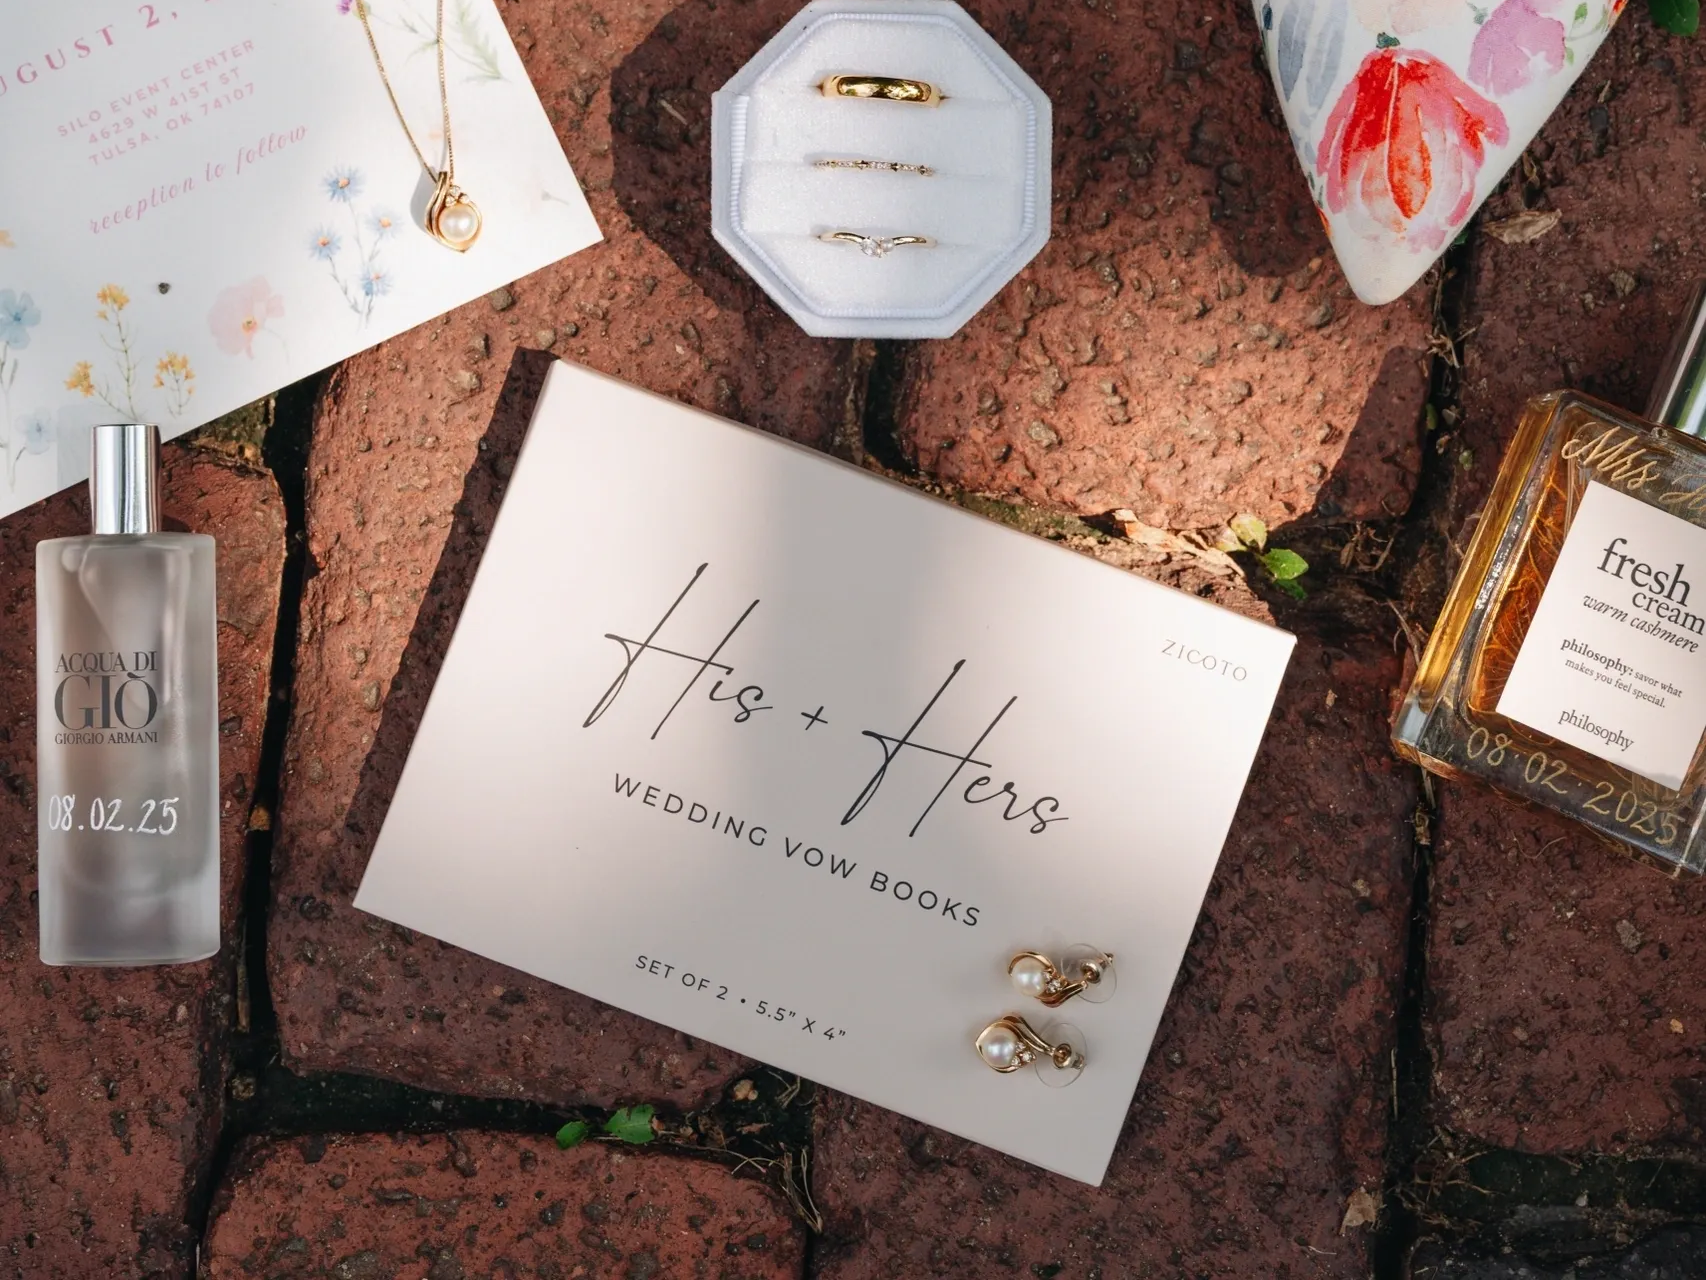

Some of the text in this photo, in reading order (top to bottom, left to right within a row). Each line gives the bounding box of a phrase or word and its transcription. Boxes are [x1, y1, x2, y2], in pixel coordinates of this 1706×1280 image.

[138, 4, 178, 29] 2,
[57, 39, 254, 137] SILO EVENT CENTER
[88, 66, 241, 144] 4629 W 41ST ST
[165, 112, 193, 131] OK
[200, 82, 255, 116] 74107
[90, 123, 308, 234] reception to follow
[1561, 422, 1661, 490] Mrs
[1597, 537, 1691, 608] fresh
[1583, 595, 1699, 654] warm cashmere
[1632, 591, 1706, 636] cream
[55, 650, 158, 673] ACQUA DI
[1161, 638, 1247, 681] ZICOTO
[1560, 638, 1683, 698] philosophy: savor what
[1564, 658, 1666, 708] makes you feel special.
[54, 671, 158, 731] GIÒ
[582, 562, 1069, 838] His + Hers
[54, 731, 159, 745] GIORGIO ARMANI
[1558, 710, 1634, 752] philosophy
[48, 794, 179, 836] 08.02.25
[614, 772, 981, 927] WEDDING VOW BOOKS
[635, 955, 675, 979] SET
[681, 972, 711, 991] OF
[715, 985, 729, 1001] 2
[801, 1017, 816, 1034] X
